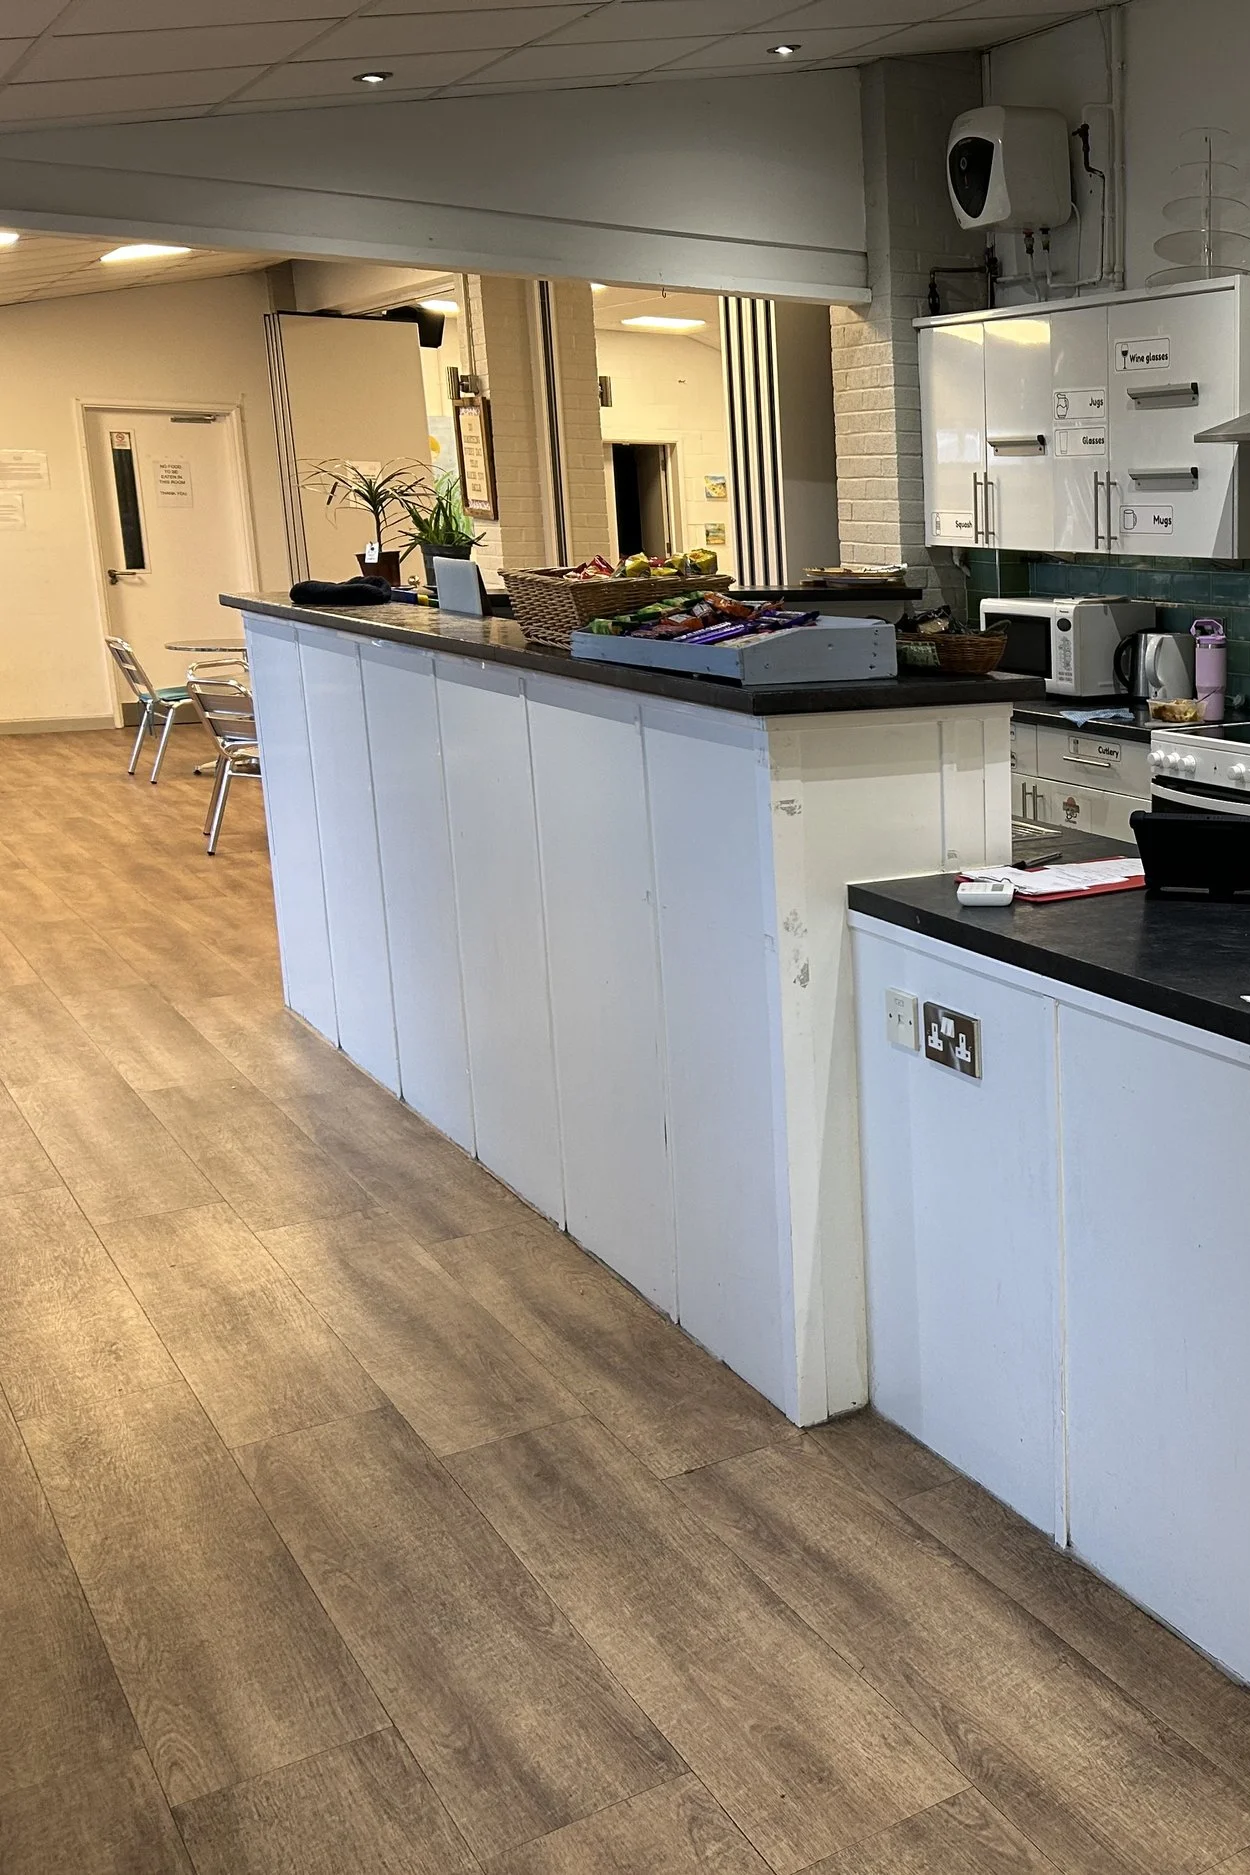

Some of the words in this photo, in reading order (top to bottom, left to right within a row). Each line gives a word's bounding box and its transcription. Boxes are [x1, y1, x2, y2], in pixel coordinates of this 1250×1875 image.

[1129, 353, 1144, 363] Wine
[1145, 352, 1168, 364] glasses
[1089, 397, 1104, 408] Jugs
[1082, 436, 1105, 445] Glasses
[955, 520, 972, 530] Squash
[1153, 514, 1172, 526] Mugs
[1098, 746, 1119, 758] Cutlery
